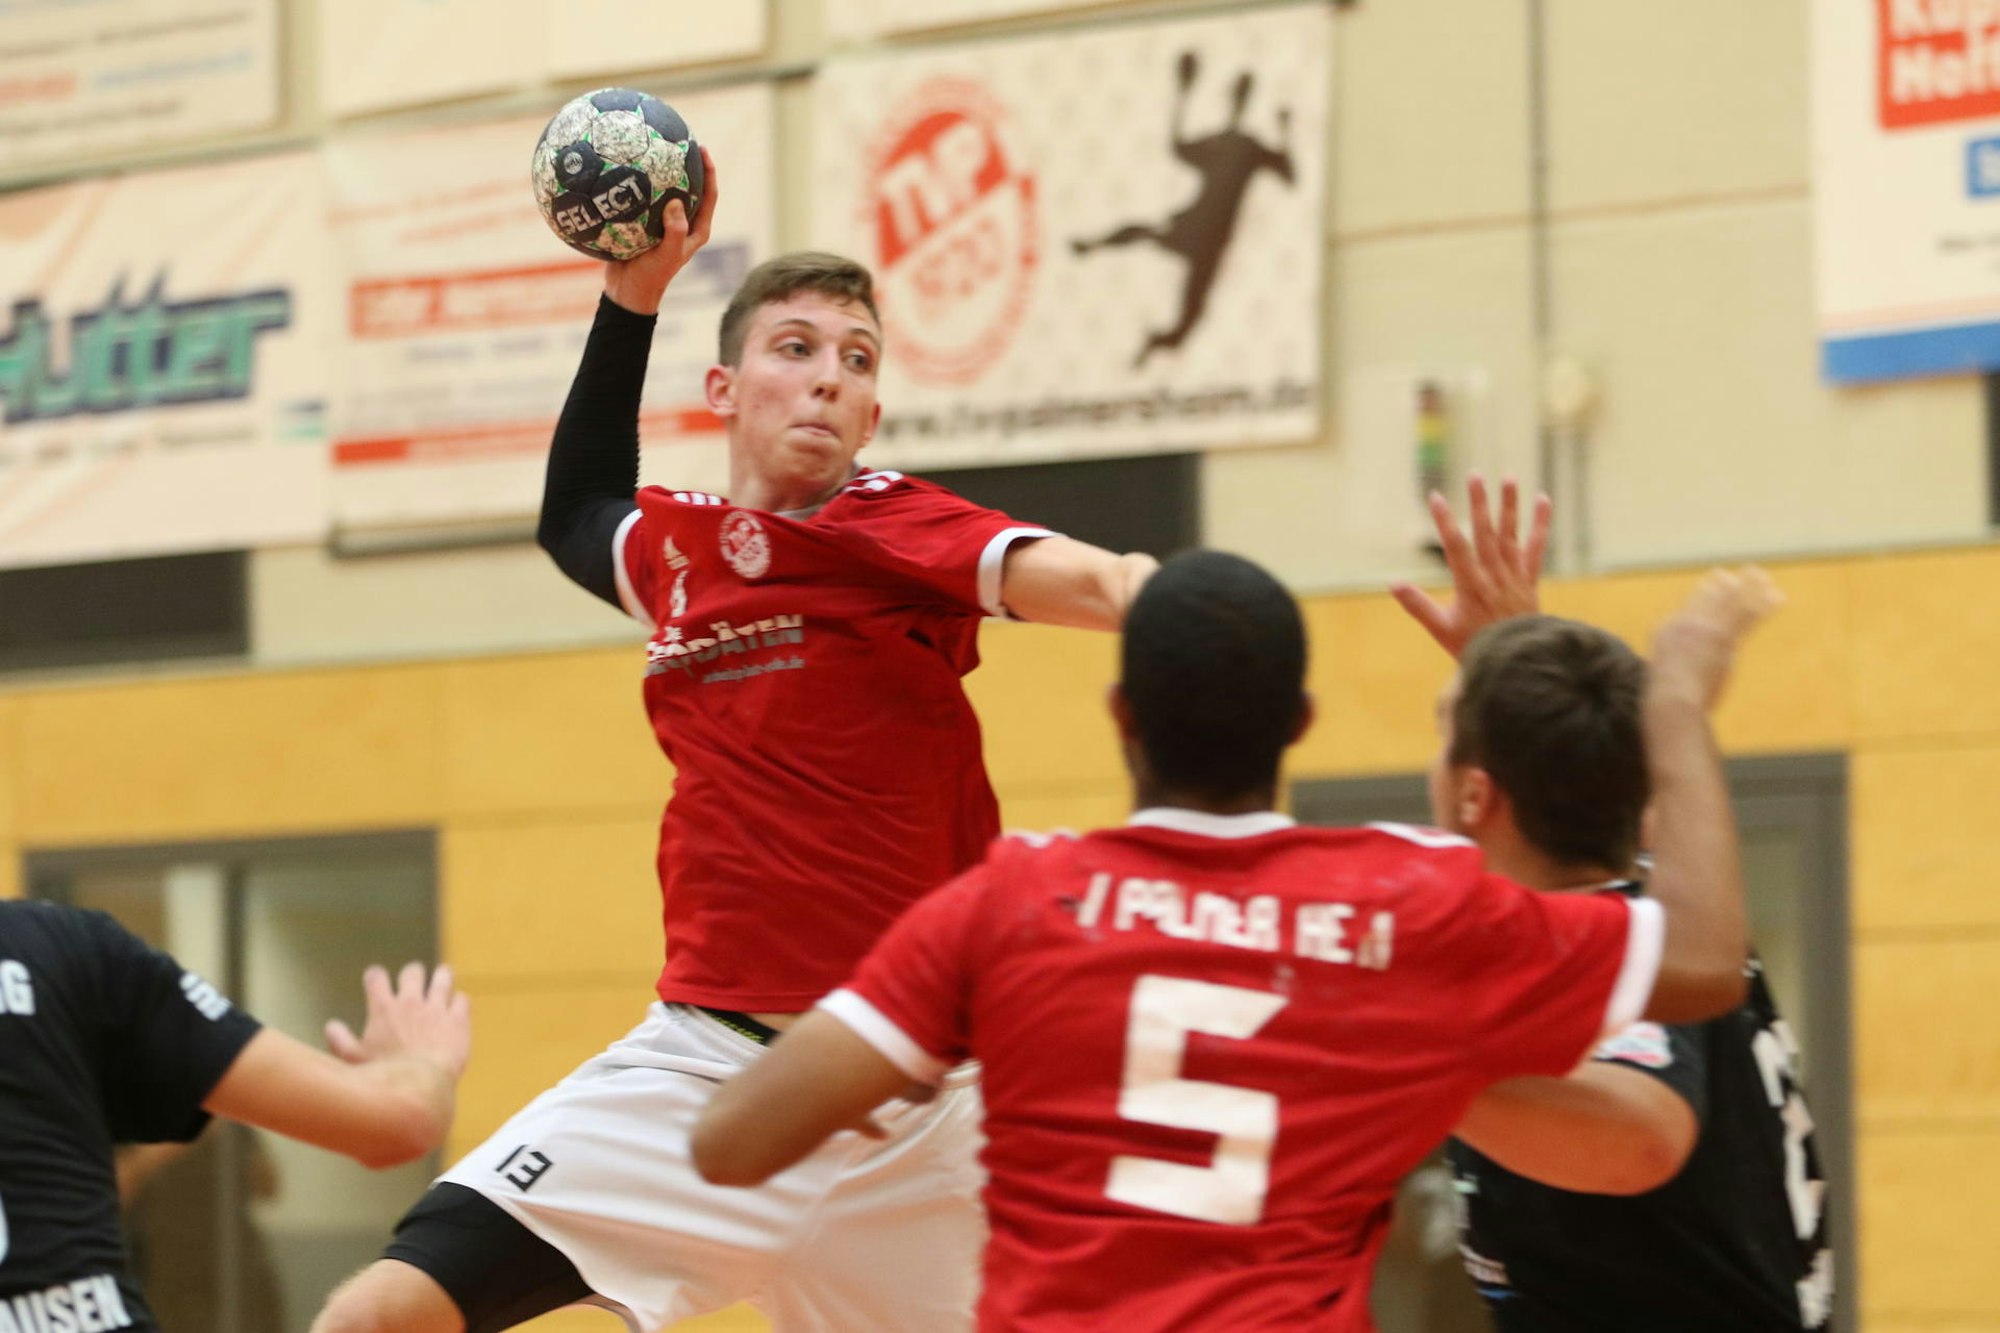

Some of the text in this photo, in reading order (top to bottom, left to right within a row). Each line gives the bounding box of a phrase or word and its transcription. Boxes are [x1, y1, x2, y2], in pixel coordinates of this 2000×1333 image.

[556, 175, 645, 236] SELECT
[1104, 973, 1290, 1229] 5
[496, 1144, 554, 1193] 13
